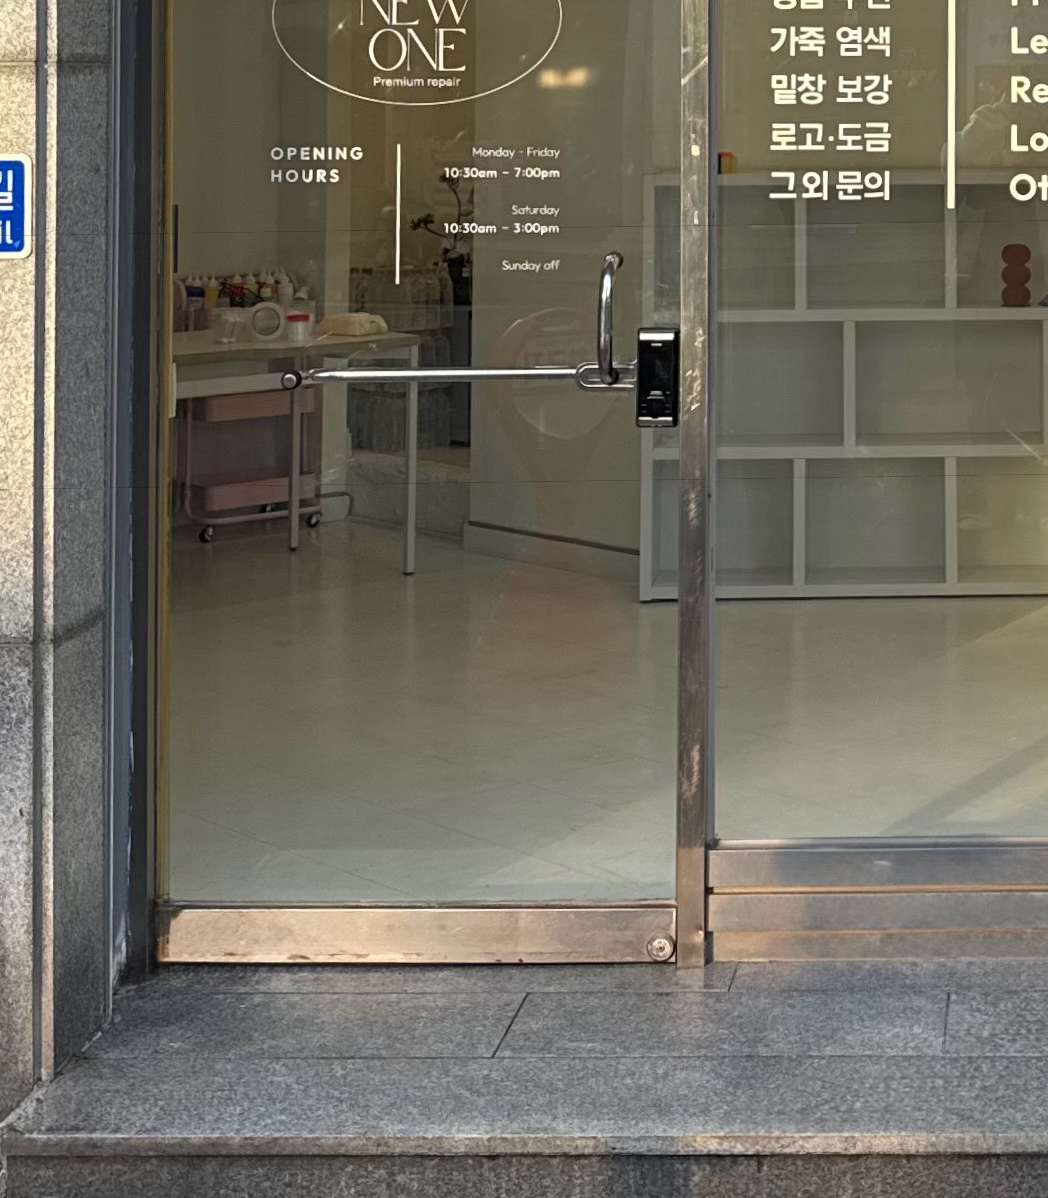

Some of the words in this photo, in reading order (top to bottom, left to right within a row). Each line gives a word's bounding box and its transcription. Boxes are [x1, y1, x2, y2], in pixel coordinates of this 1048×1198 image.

[770, 26, 826, 57] 가죽
[835, 26, 891, 57] 염색
[368, 27, 467, 72] ONE
[373, 76, 425, 88] Premium
[427, 76, 461, 89] repair
[770, 73, 827, 105] 밑창
[836, 74, 893, 105] 보강
[270, 146, 364, 161] OPENING
[472, 146, 516, 160] Monday
[526, 146, 561, 160] Friday
[270, 168, 340, 184] HOURS
[444, 166, 498, 179] 10:30am
[513, 166, 561, 181] 7:00pm
[835, 170, 890, 201] 문의
[511, 204, 560, 218] Saturday
[443, 222, 497, 234] 10:30am
[513, 222, 560, 236] 3:00pm
[501, 259, 542, 273] Sunday
[543, 259, 561, 271] off
